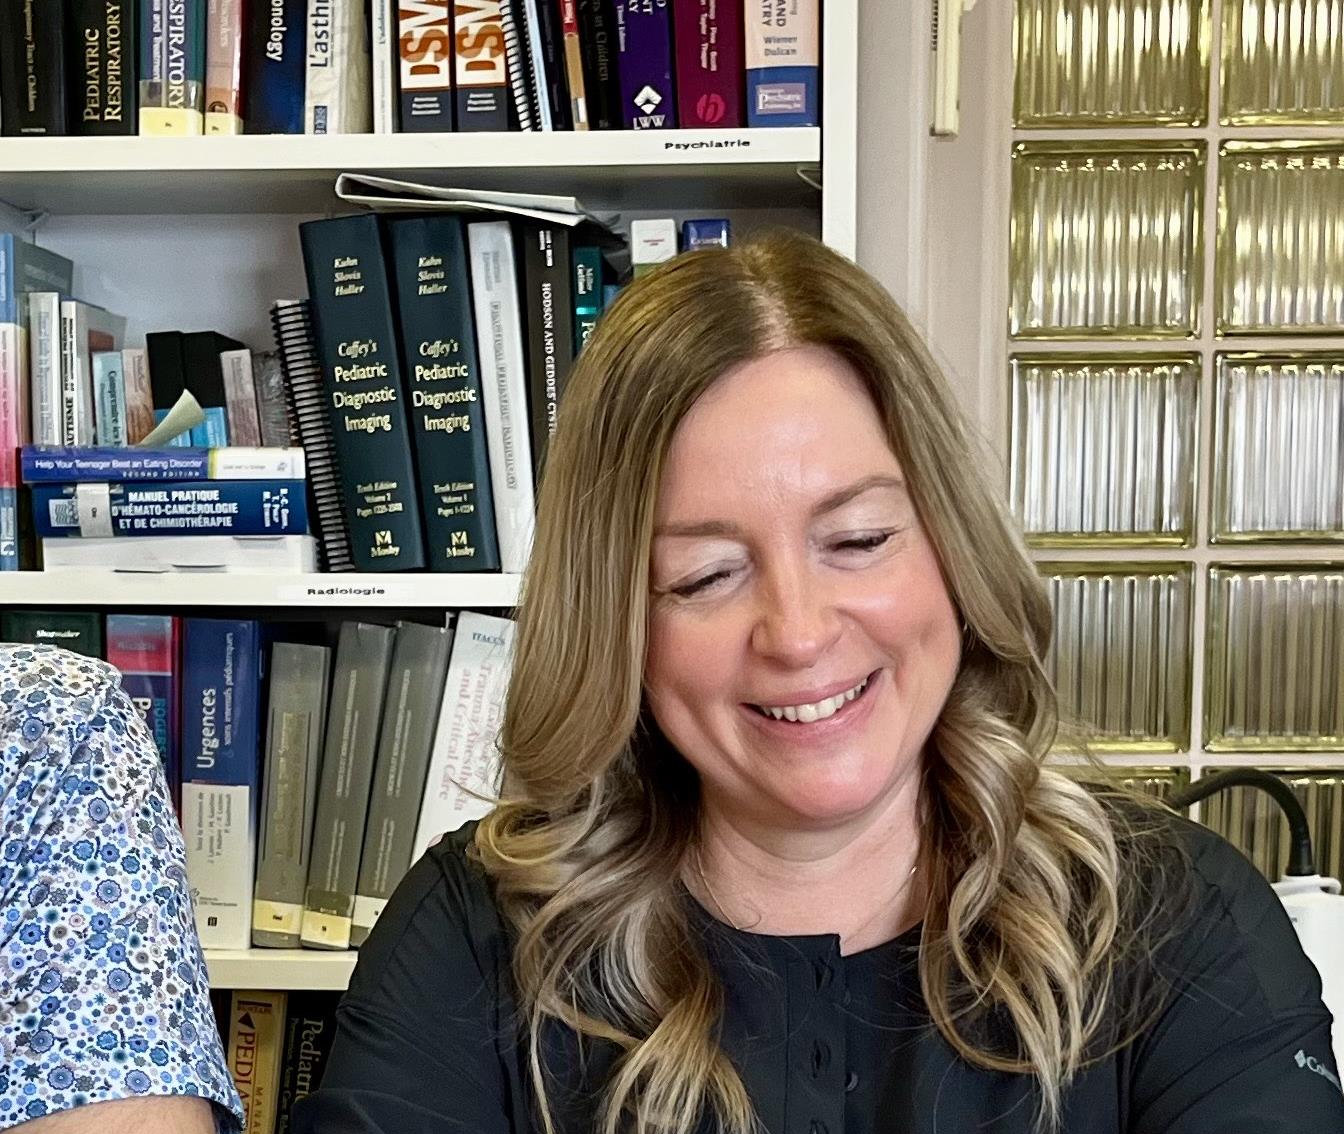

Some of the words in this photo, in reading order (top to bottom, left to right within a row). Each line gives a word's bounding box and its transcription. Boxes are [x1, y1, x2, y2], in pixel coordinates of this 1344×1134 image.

[152, 14, 162, 33] and
[699, 13, 708, 34] Taylor
[104, 1, 122, 122] RESPIRATORY
[152, 36, 163, 82] Treatment
[82, 28, 100, 122] PEDIATRIC
[28, 75, 37, 112] Children
[632, 112, 666, 131] LWW
[664, 137, 751, 151] Psychiatrie
[335, 282, 364, 296] Haller
[418, 282, 448, 296] Haller
[541, 283, 553, 328] HODSON
[337, 339, 377, 359] Caffey's
[419, 339, 459, 358] Caffey's
[543, 330, 554, 354] AND
[335, 364, 388, 382] Pediatric
[415, 363, 468, 382] Pediatric
[107, 370, 118, 424] Comprendre
[333, 387, 396, 409] Diagnostic
[413, 386, 477, 408] Diagnostic
[65, 397, 75, 447] AUTISME
[345, 413, 392, 434] Imaging
[424, 413, 470, 434] Imaging
[35, 460, 55, 469] Help
[56, 460, 74, 469] Your
[75, 459, 110, 470] Teenager
[144, 459, 168, 469] Eating
[170, 459, 203, 468] Disorder
[128, 491, 170, 503] MANUEL
[171, 490, 219, 502] PRATIQUE
[374, 481, 397, 491] Edition
[119, 518, 133, 529] ET
[134, 518, 149, 529] DE
[150, 514, 233, 529] CHIMIOTHÉRAPIE
[371, 546, 401, 557] Mosby
[447, 547, 475, 558] Mosby
[307, 586, 385, 596] Radiologie
[457, 669, 471, 699] and
[472, 664, 492, 724] Trauma
[197, 688, 219, 768] Urgences
[224, 724, 233, 746] soins
[446, 702, 466, 760] Critical
[439, 764, 456, 801] Care
